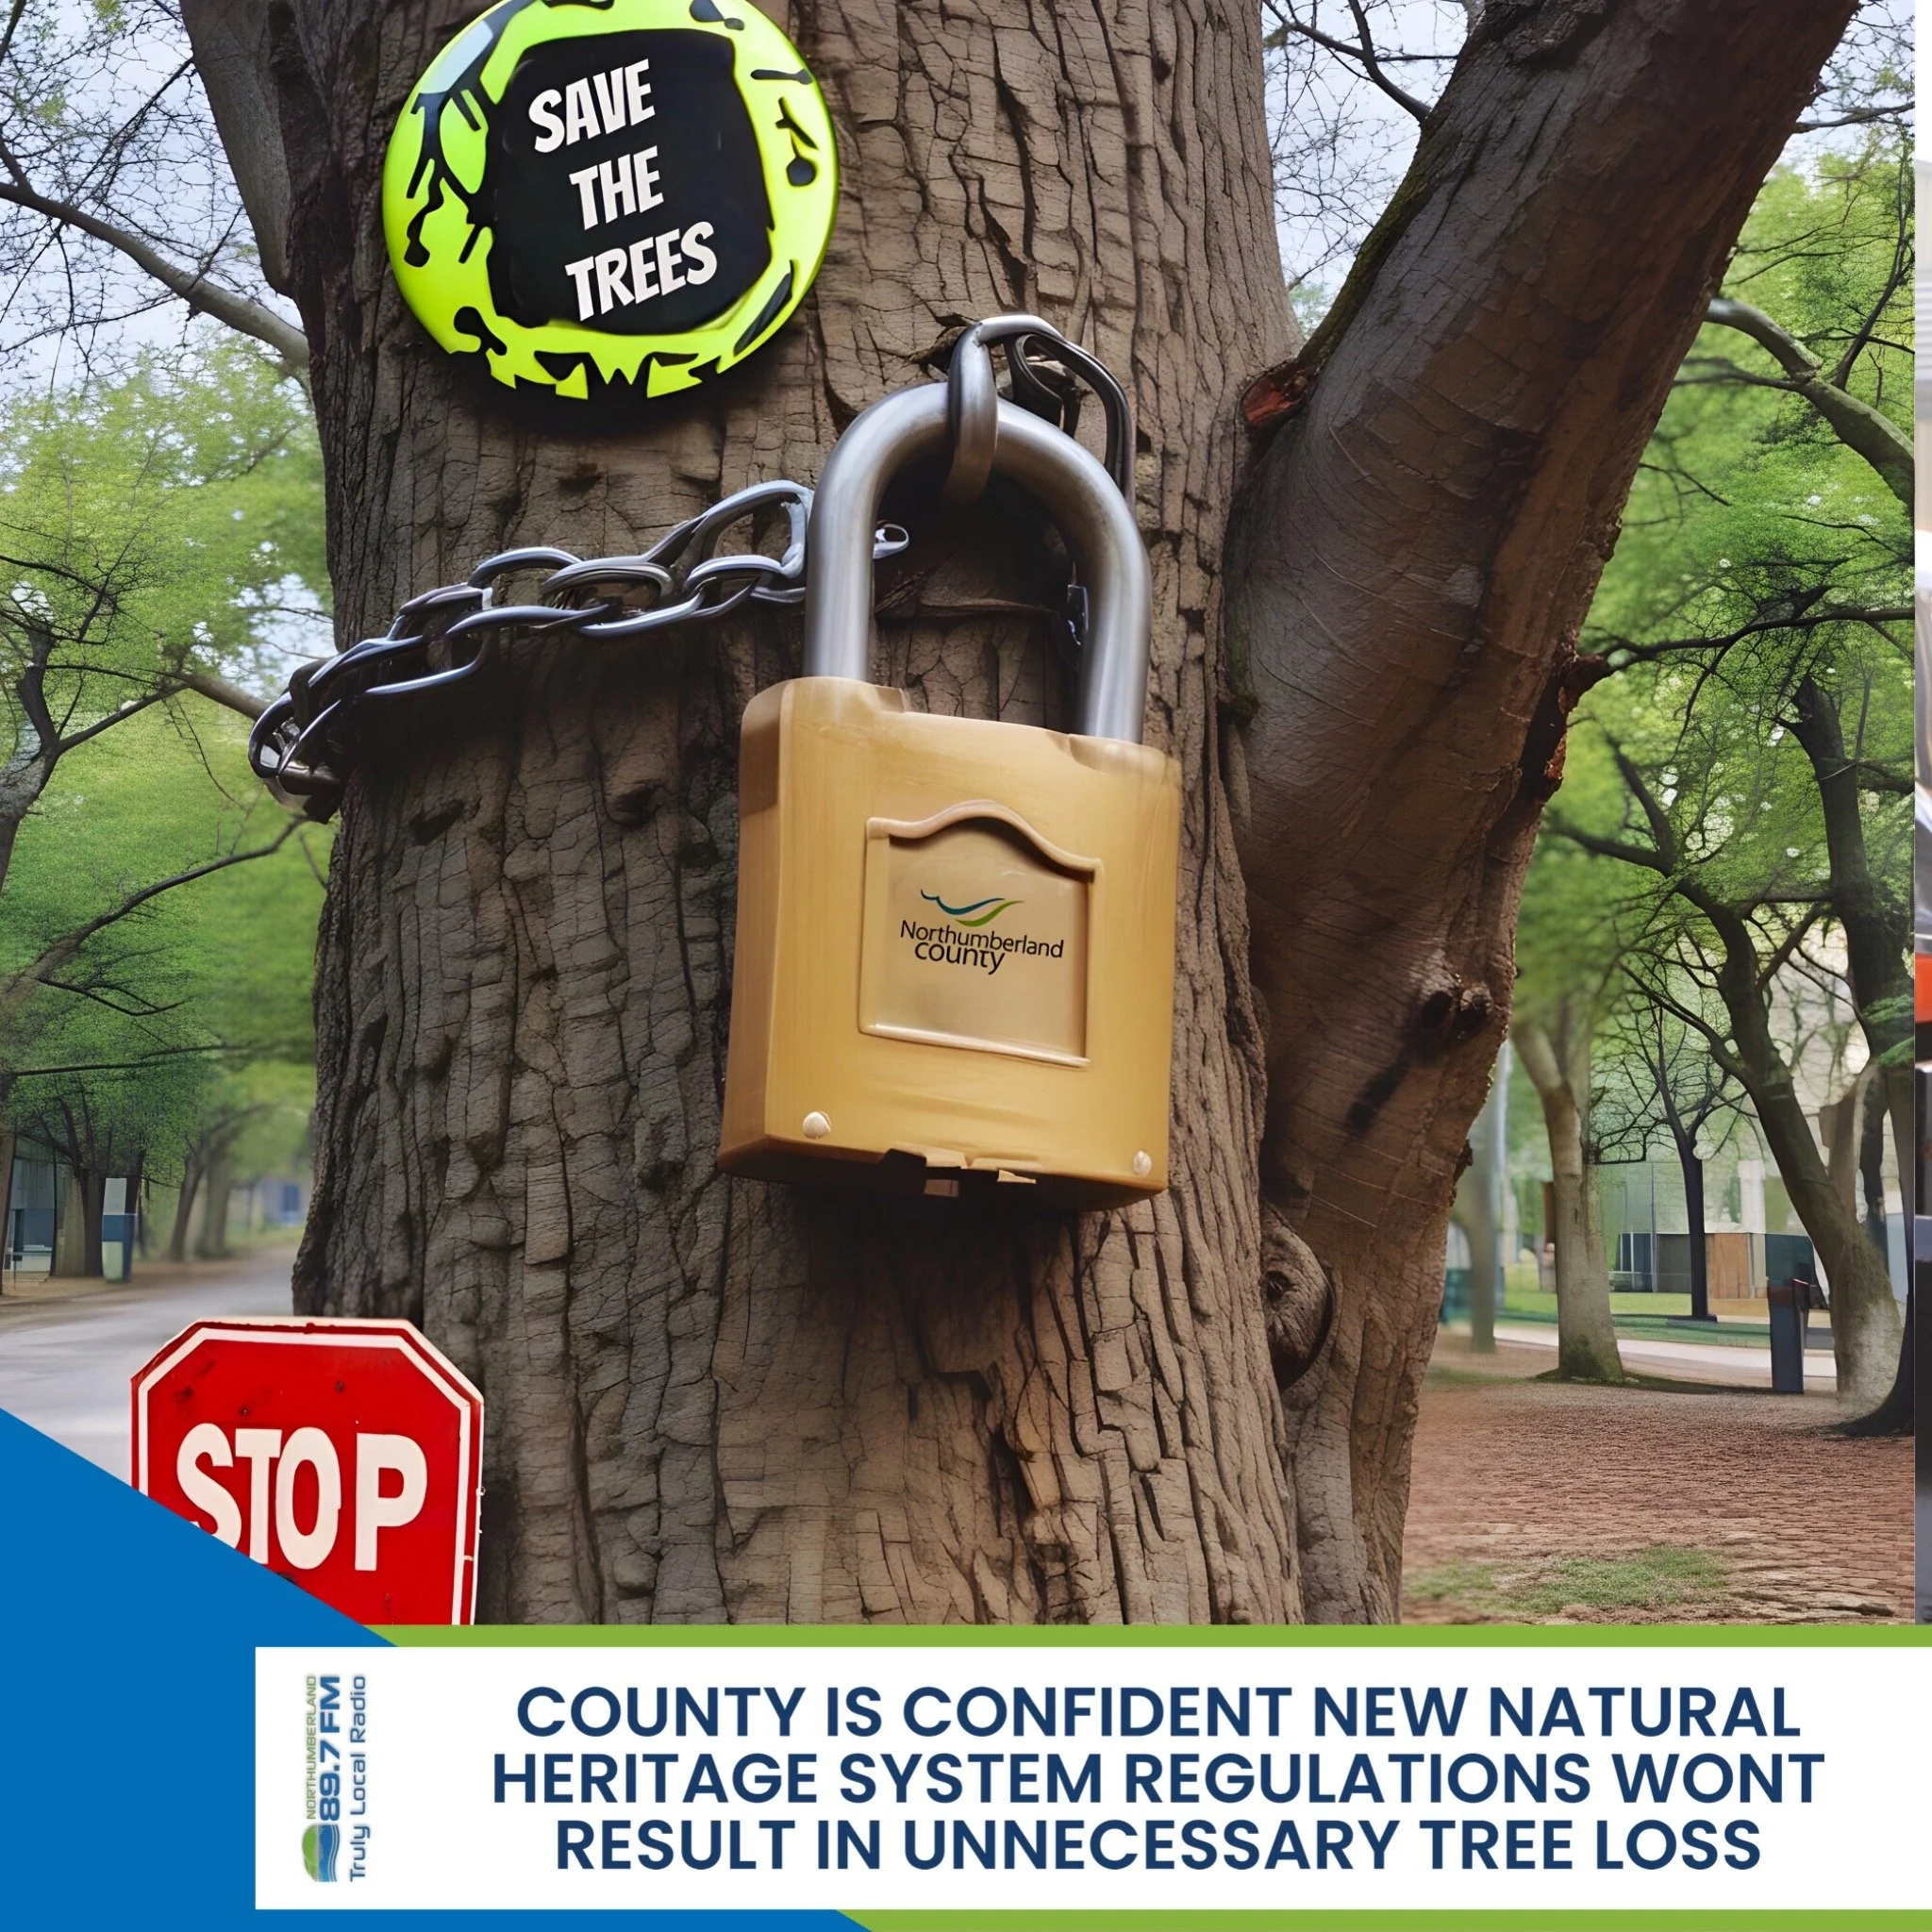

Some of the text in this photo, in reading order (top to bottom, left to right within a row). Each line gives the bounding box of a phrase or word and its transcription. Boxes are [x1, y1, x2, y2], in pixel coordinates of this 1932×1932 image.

[528, 58, 656, 153] SAVE
[569, 145, 664, 230] THE
[565, 221, 718, 322] TREES
[900, 920, 1065, 958] Northumberland
[914, 941, 1006, 975] county
[176, 1423, 428, 1572] STOP
